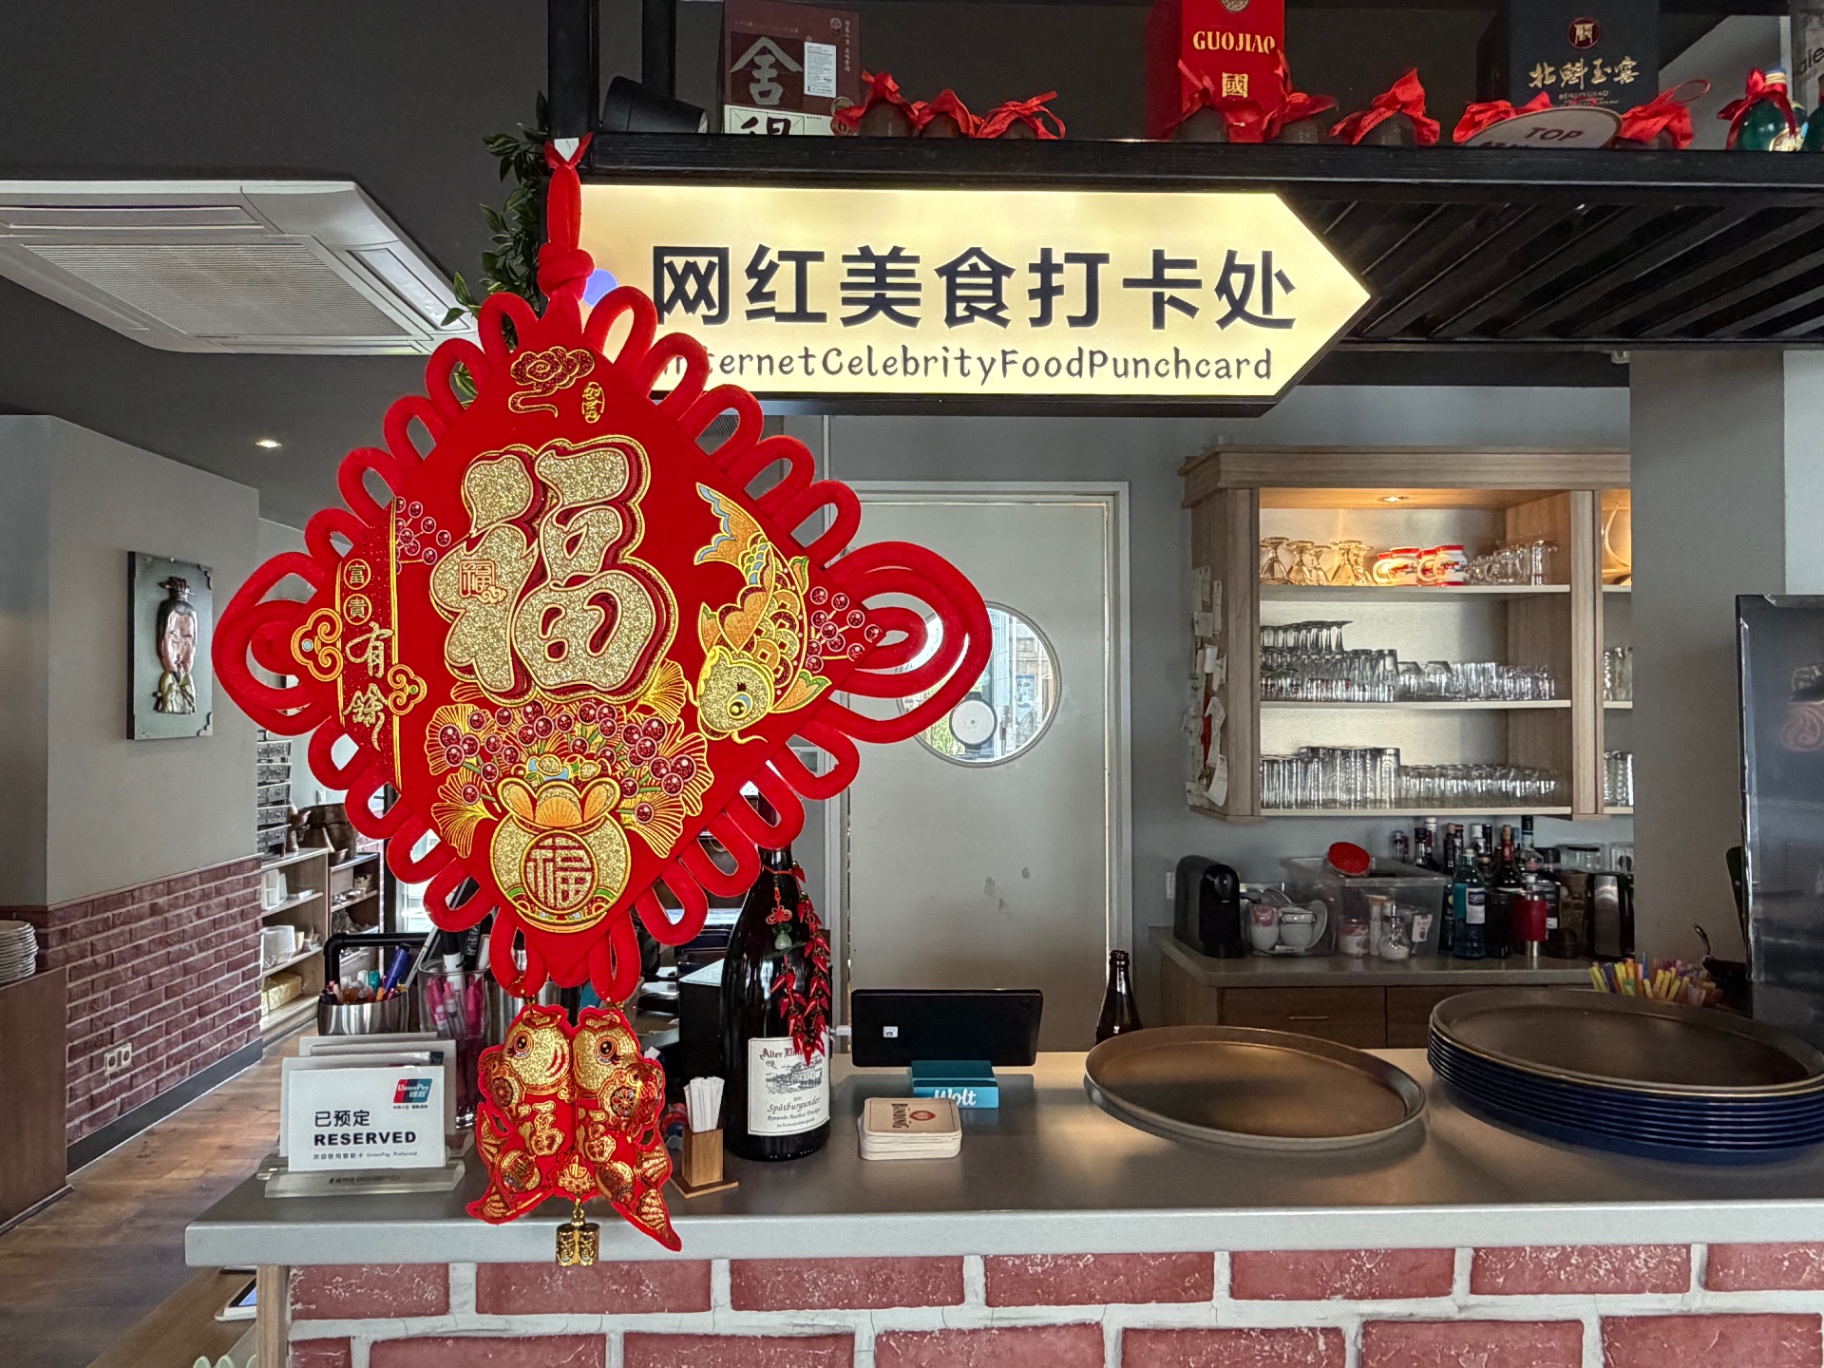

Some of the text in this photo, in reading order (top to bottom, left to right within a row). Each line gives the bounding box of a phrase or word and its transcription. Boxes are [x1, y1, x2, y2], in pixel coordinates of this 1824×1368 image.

[1192, 30, 1276, 55] GUOJIAO
[729, 36, 804, 106] 舍
[1222, 71, 1249, 98] 國
[1525, 126, 1584, 142] TOP
[652, 242, 1297, 331] 网红美食打卡处
[662, 344, 1273, 387] ernetCelebrityFoodPunchcard
[431, 434, 678, 706] 福
[526, 836, 594, 909] 福
[314, 1109, 370, 1127] 已预定
[314, 1131, 417, 1146] RESERVED
